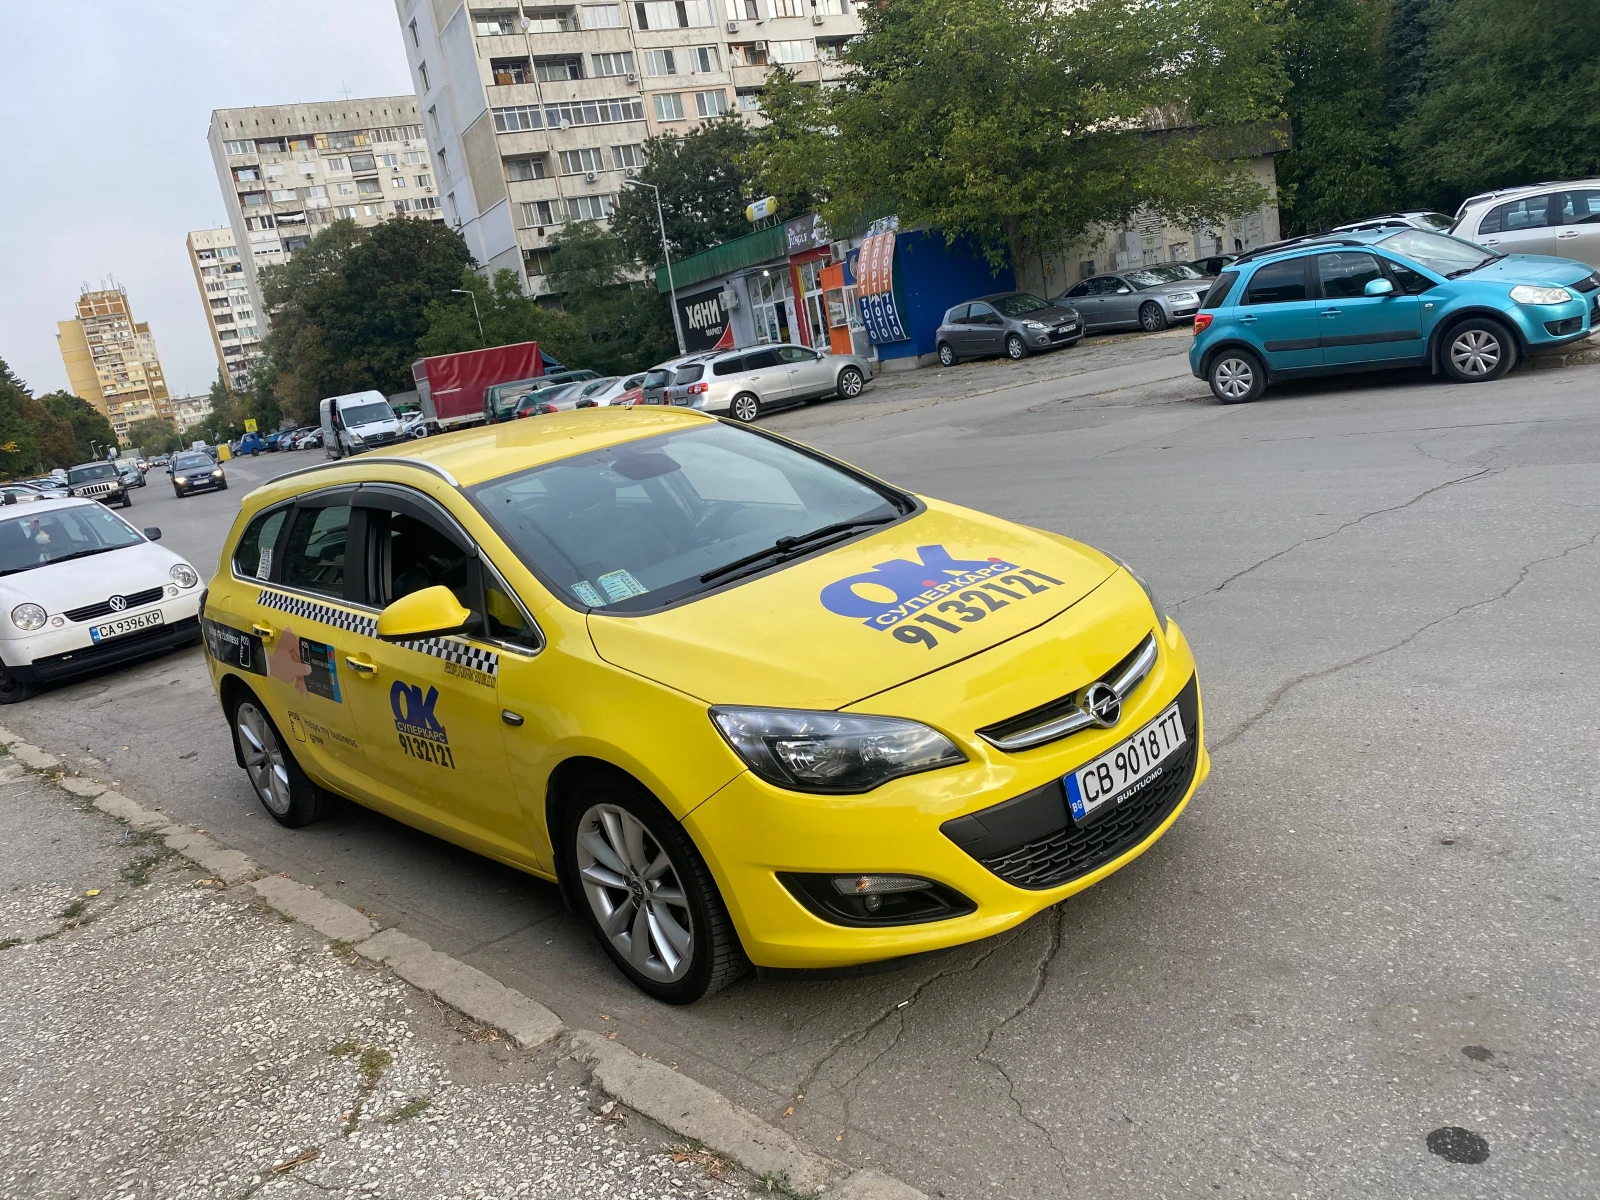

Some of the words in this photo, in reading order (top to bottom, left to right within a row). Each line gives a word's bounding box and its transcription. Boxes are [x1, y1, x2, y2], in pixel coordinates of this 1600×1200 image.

[685, 298, 721, 330] ХАНИ
[861, 297, 877, 340] ТОТО
[705, 326, 723, 337] МАРКЕТ
[875, 563, 1011, 626] СУПЕРКАРС
[892, 568, 1066, 651] 9132121
[116, 617, 145, 633] 9396
[397, 721, 446, 743] СУПЕРКАРС
[398, 733, 456, 770] 9132121
[1082, 762, 1114, 803] CB
[1114, 729, 1161, 784] 9018
[1158, 710, 1180, 750] TT
[1071, 799, 1083, 813] BG
